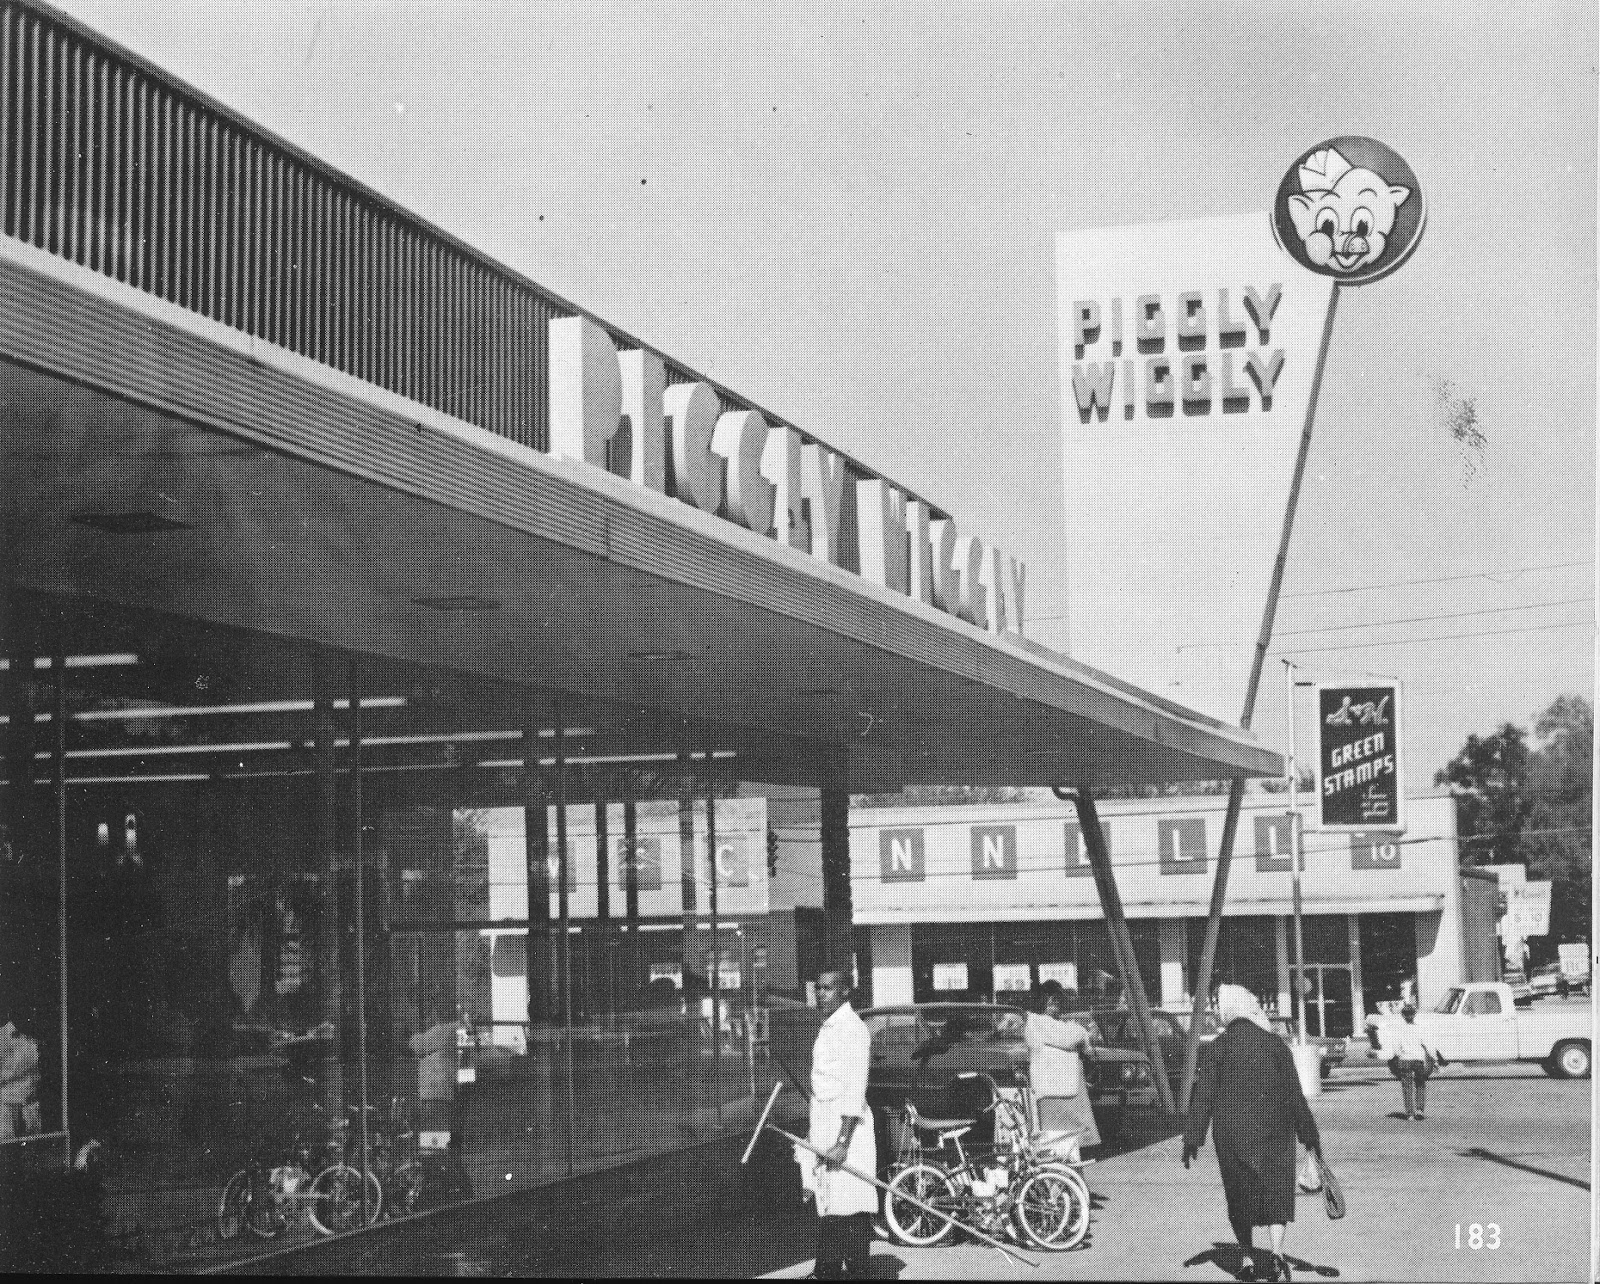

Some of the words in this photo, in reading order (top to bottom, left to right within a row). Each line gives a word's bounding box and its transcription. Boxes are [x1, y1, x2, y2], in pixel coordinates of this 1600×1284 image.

[1073, 283, 1282, 360] PIGGLY
[1072, 349, 1285, 424] WIGGLY
[1324, 754, 1394, 796] STAMPS
[1332, 732, 1384, 768] GREEN
